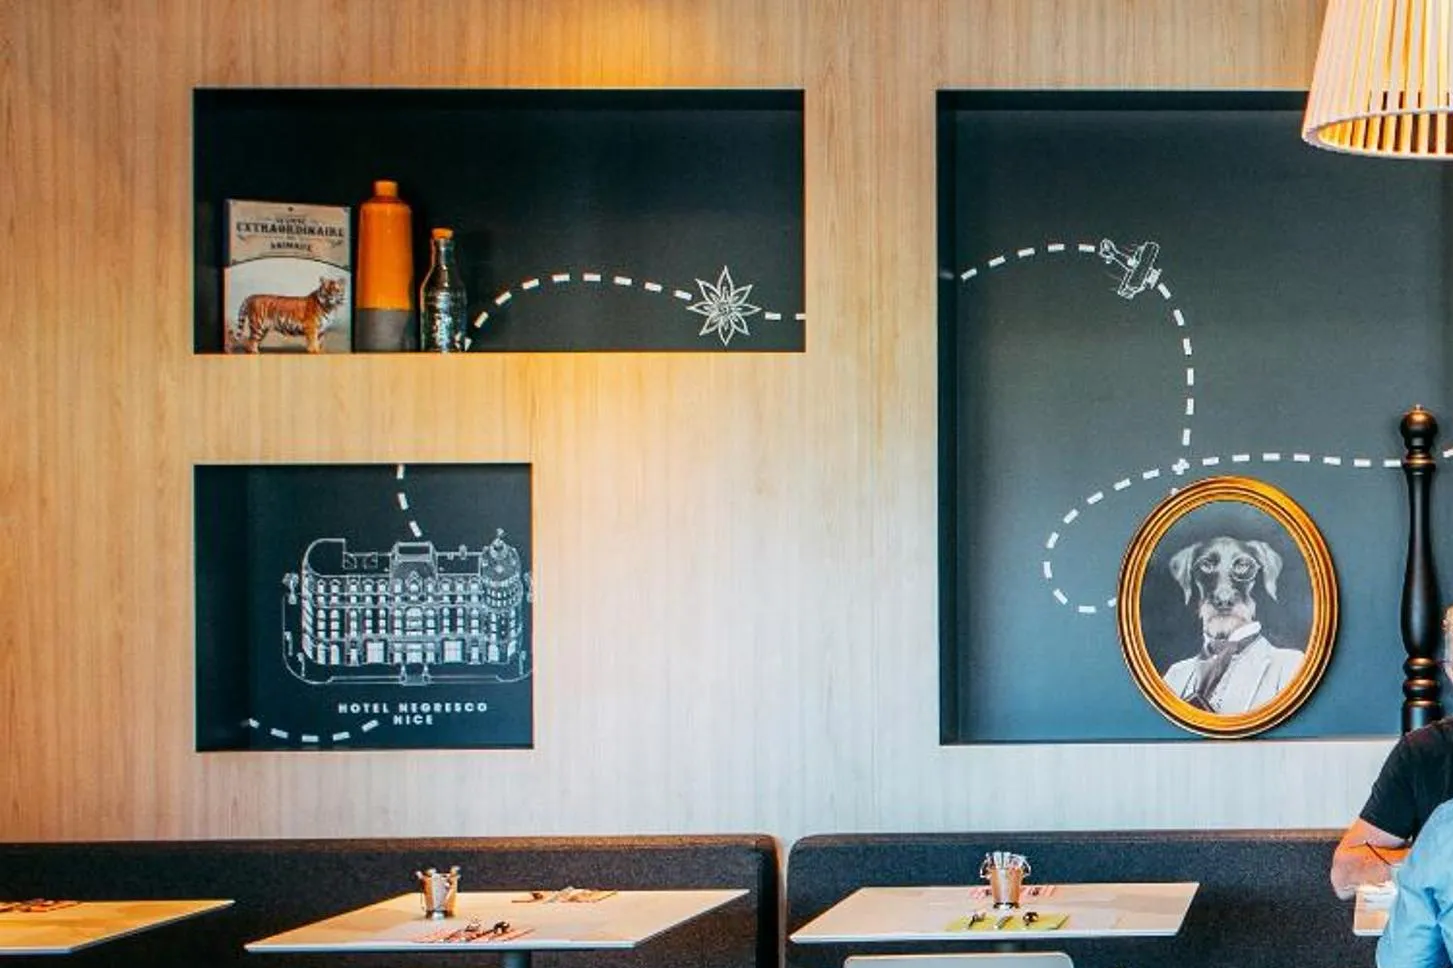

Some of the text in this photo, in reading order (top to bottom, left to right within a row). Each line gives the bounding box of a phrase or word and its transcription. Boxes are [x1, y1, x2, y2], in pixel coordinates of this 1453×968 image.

[236, 222, 345, 238] EXTRAORDINAIRE
[338, 702, 488, 714] HOTEL NEGRESCO
[393, 714, 433, 725] NICE
